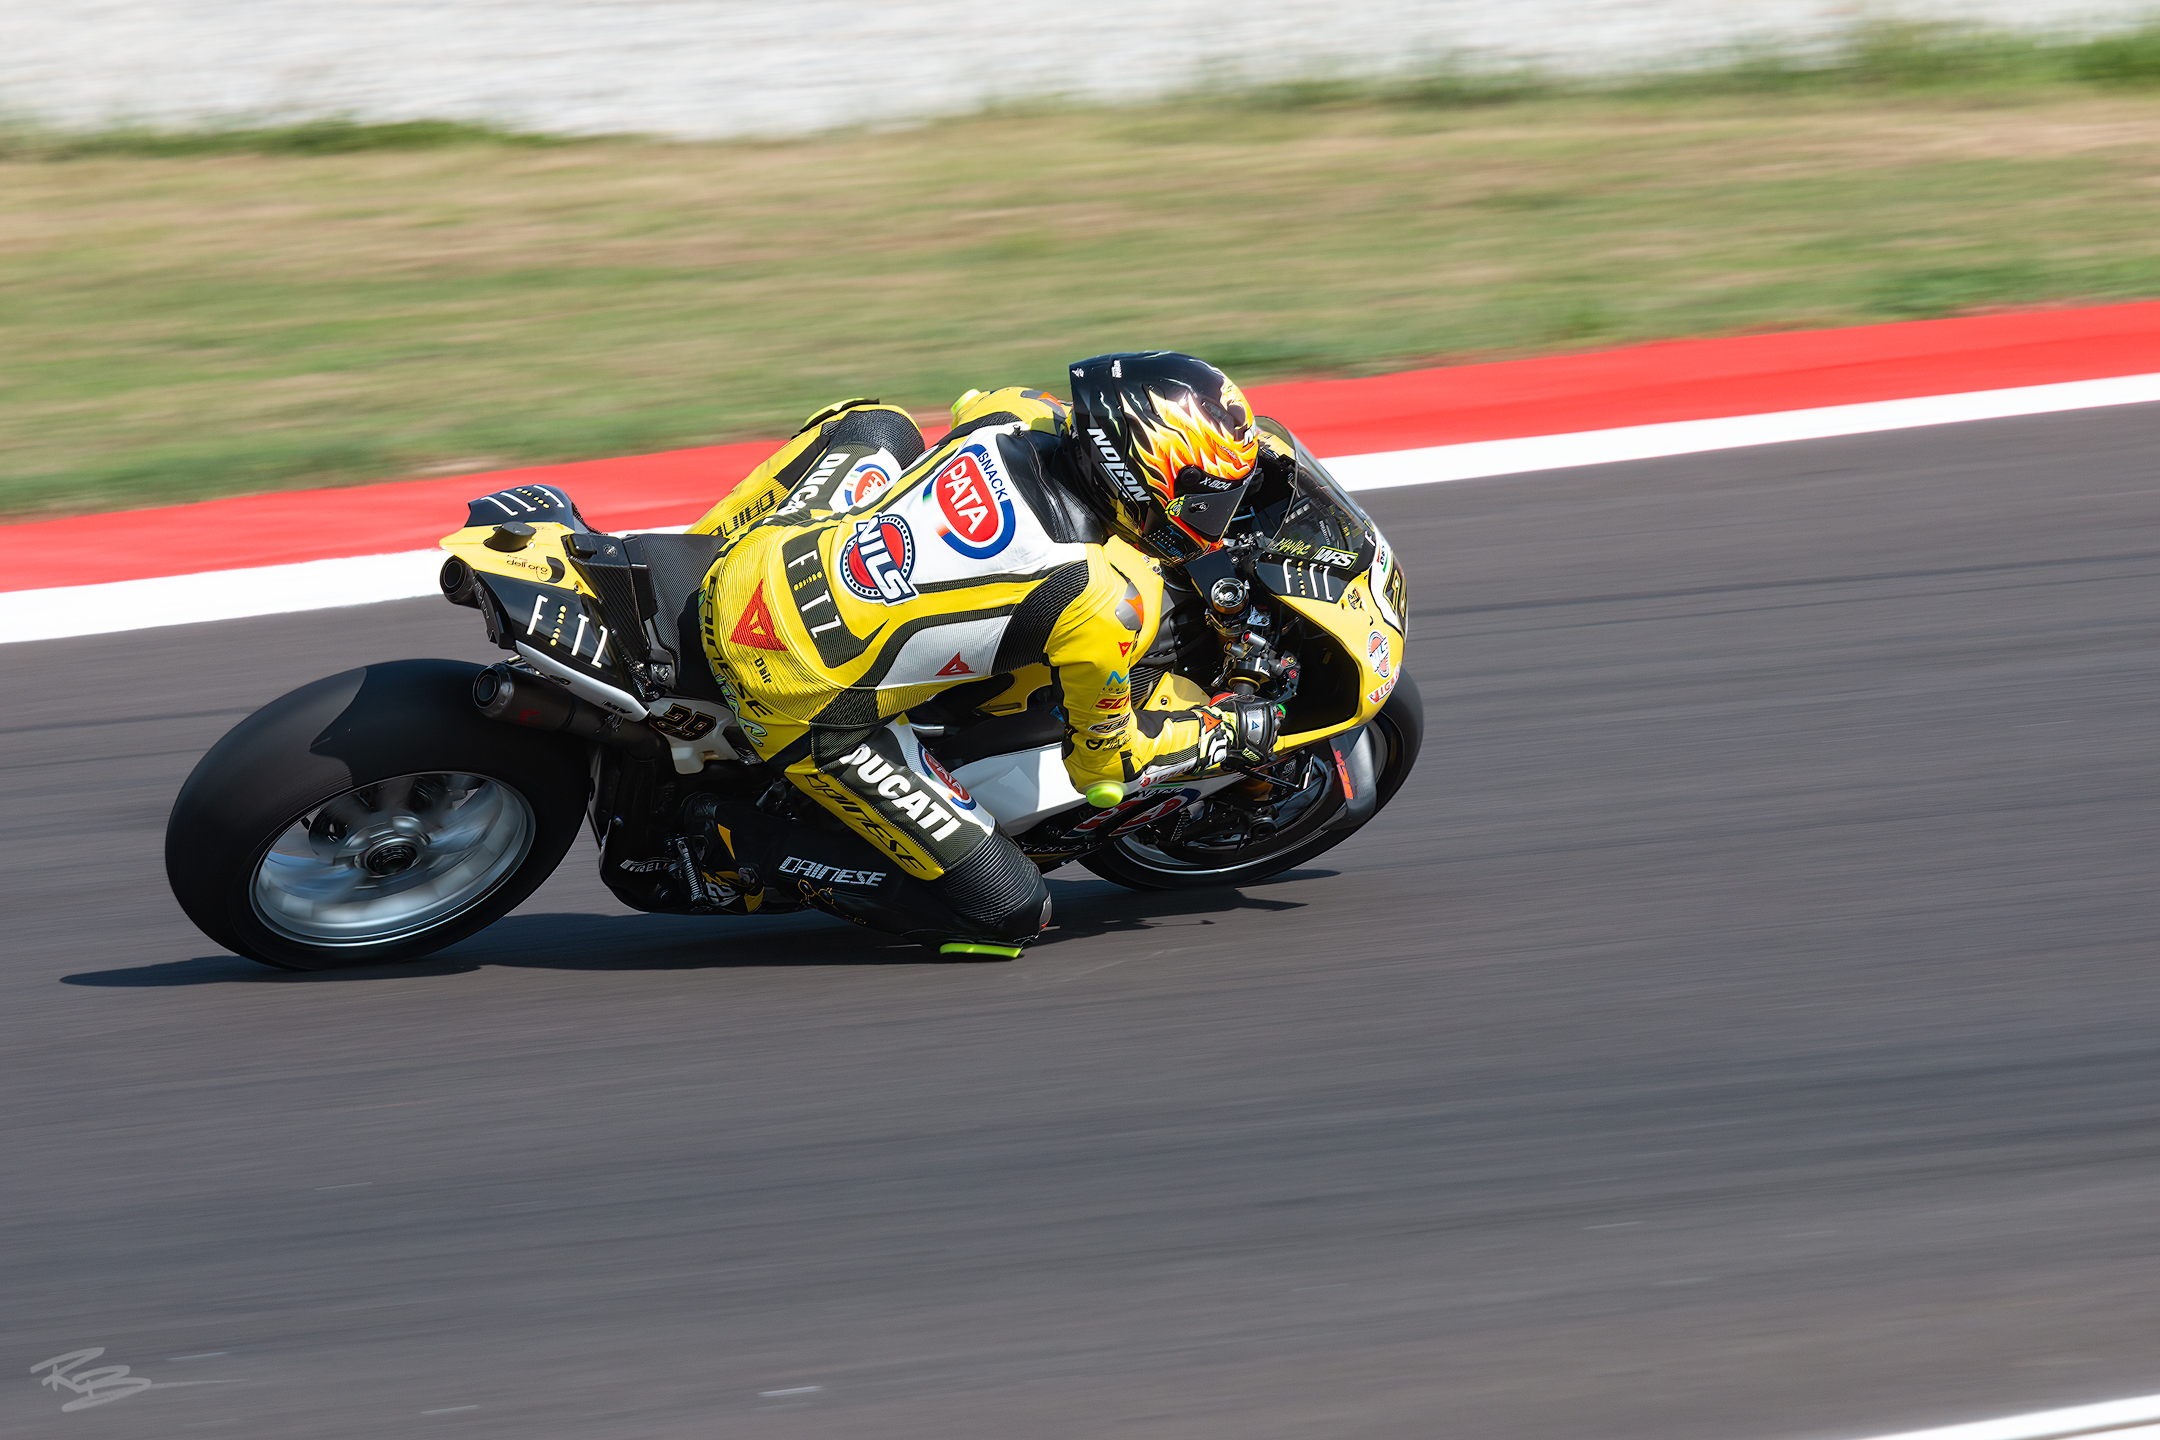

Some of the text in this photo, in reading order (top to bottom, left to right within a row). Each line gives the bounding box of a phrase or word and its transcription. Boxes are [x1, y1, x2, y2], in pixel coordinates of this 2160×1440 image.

[943, 459, 989, 535] PATA
[978, 452, 1009, 501] SNACK
[857, 515, 916, 602] NILS
[839, 743, 962, 842] DUCATI
[778, 855, 887, 887] DAINESE
